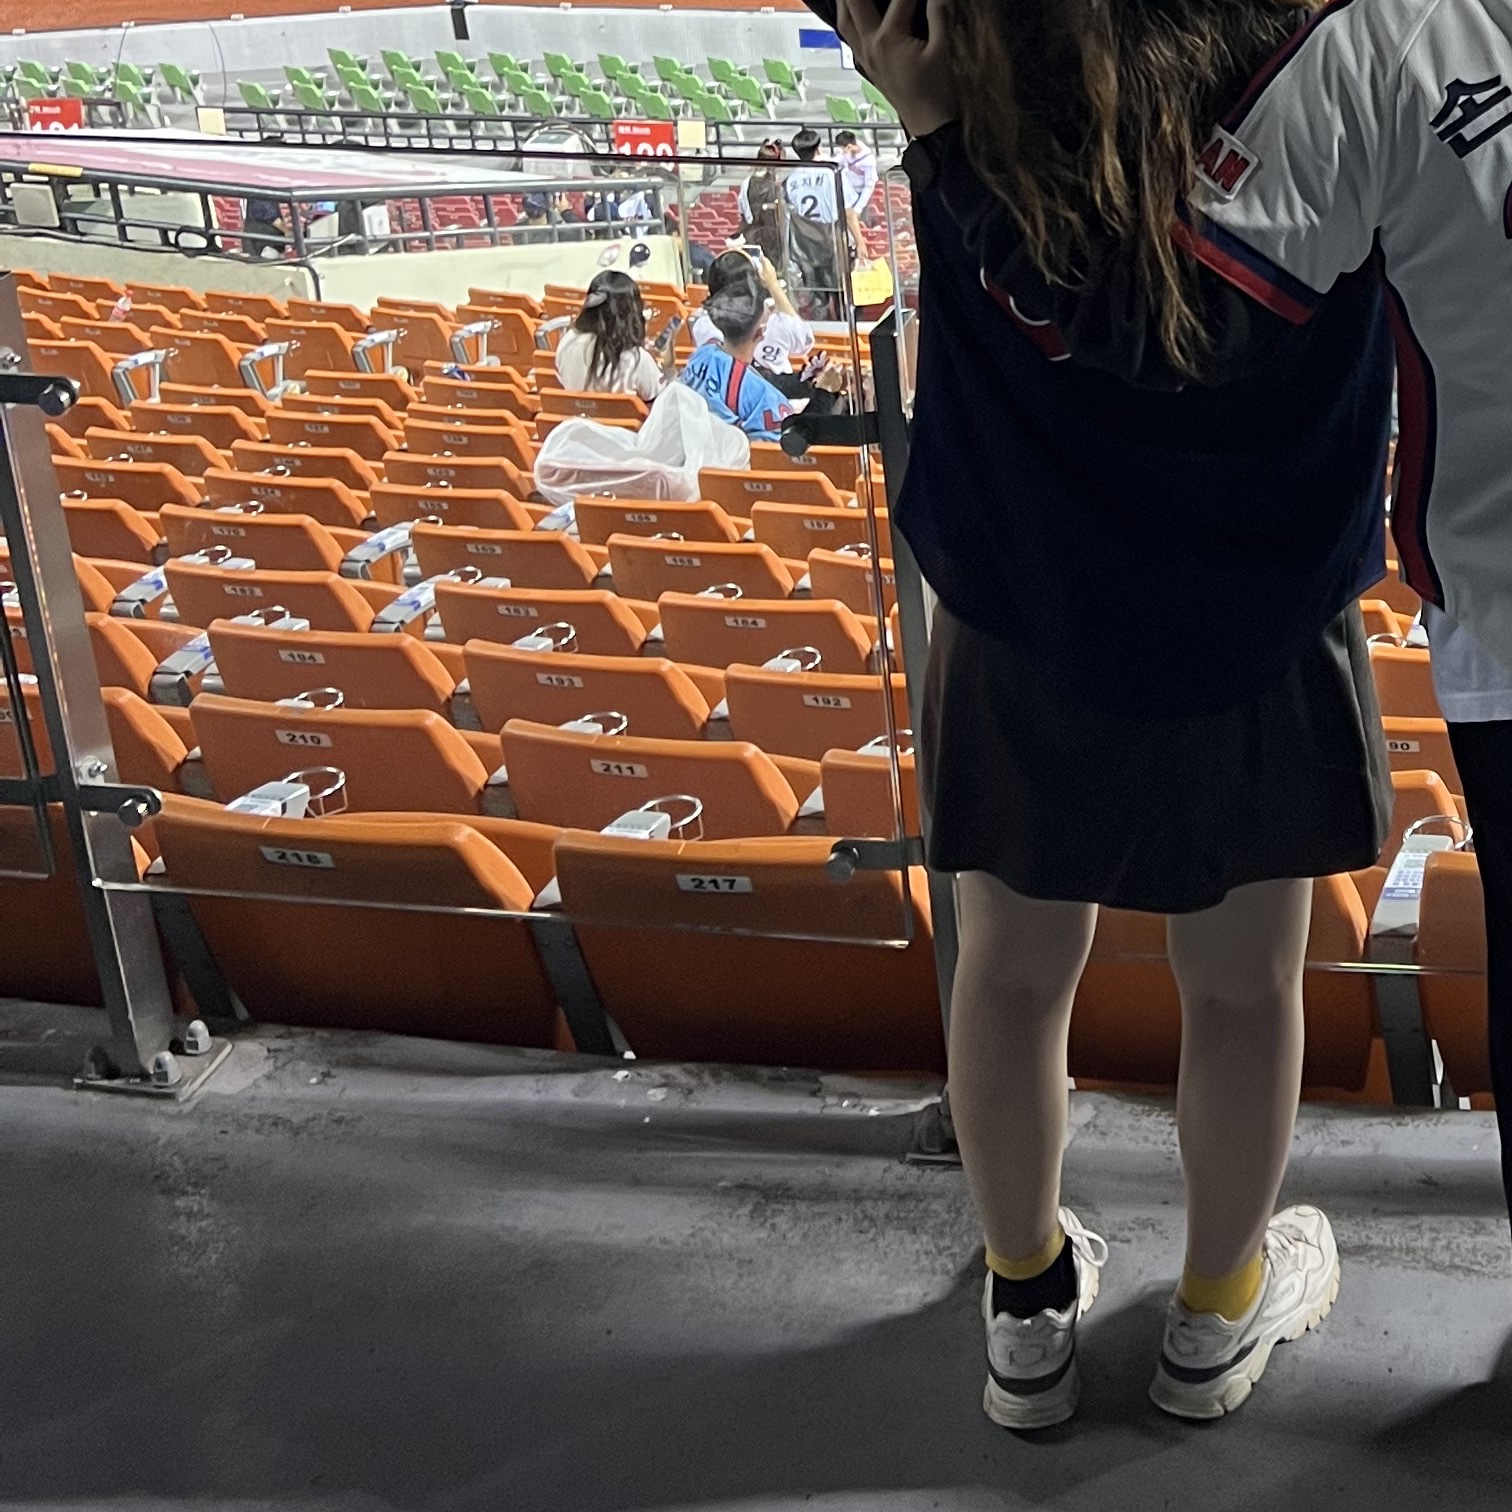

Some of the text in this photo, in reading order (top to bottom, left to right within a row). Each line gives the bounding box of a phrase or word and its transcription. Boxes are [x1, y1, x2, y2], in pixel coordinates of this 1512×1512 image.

[801, 195, 820, 218] 2
[732, 618, 759, 627] 184
[545, 675, 575, 686] 193
[812, 696, 841, 706] 192
[286, 733, 320, 745] 210
[601, 763, 630, 774] 211
[277, 851, 321, 864] 218
[692, 878, 736, 890] 217
